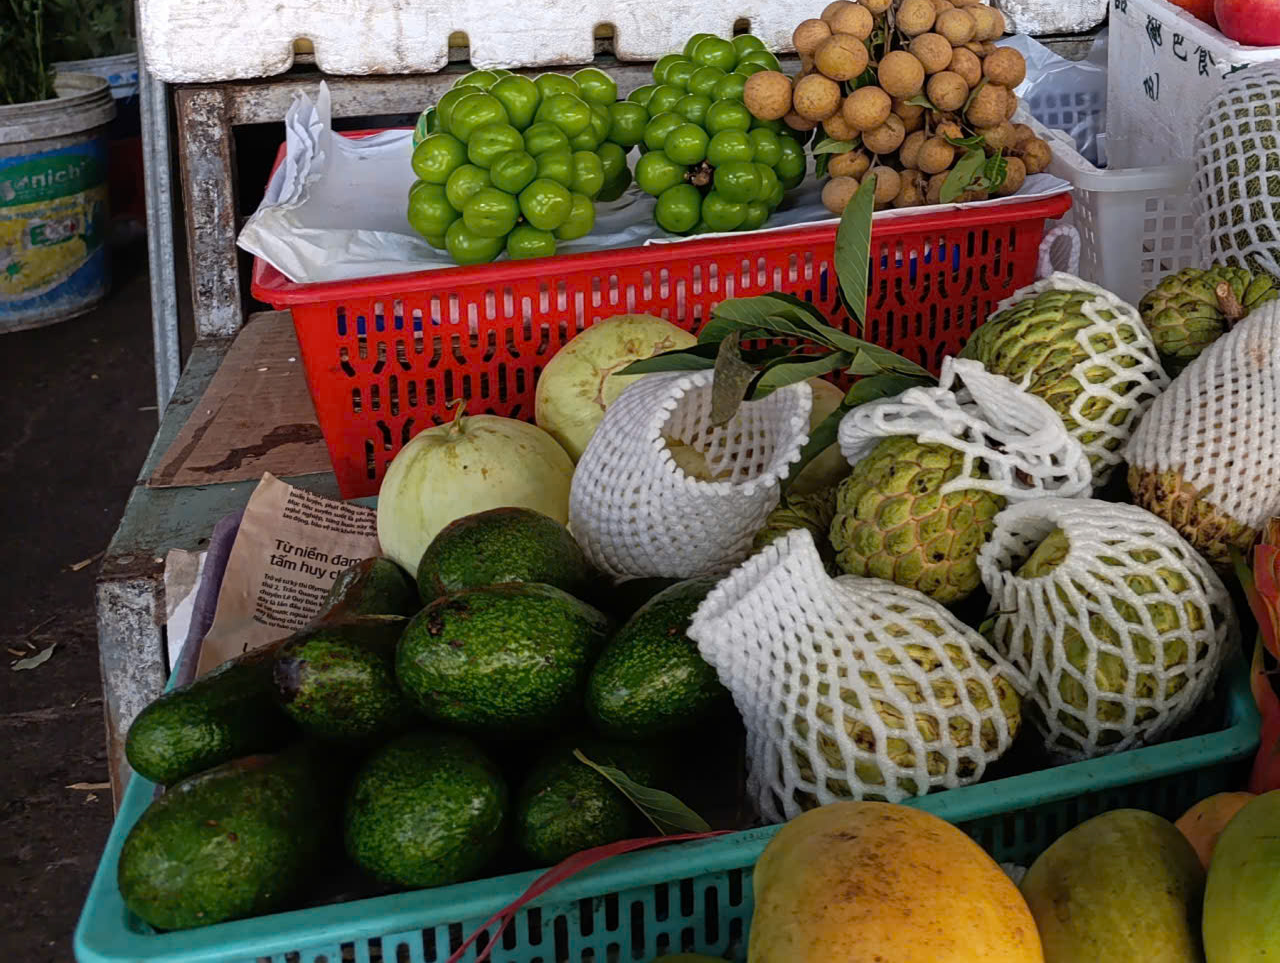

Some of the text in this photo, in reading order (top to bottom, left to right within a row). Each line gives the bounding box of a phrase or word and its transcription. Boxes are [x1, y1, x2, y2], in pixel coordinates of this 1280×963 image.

[275, 538, 293, 553] Từ
[294, 546, 328, 563] niềm
[270, 554, 297, 570] tấm
[299, 560, 327, 579] huy
